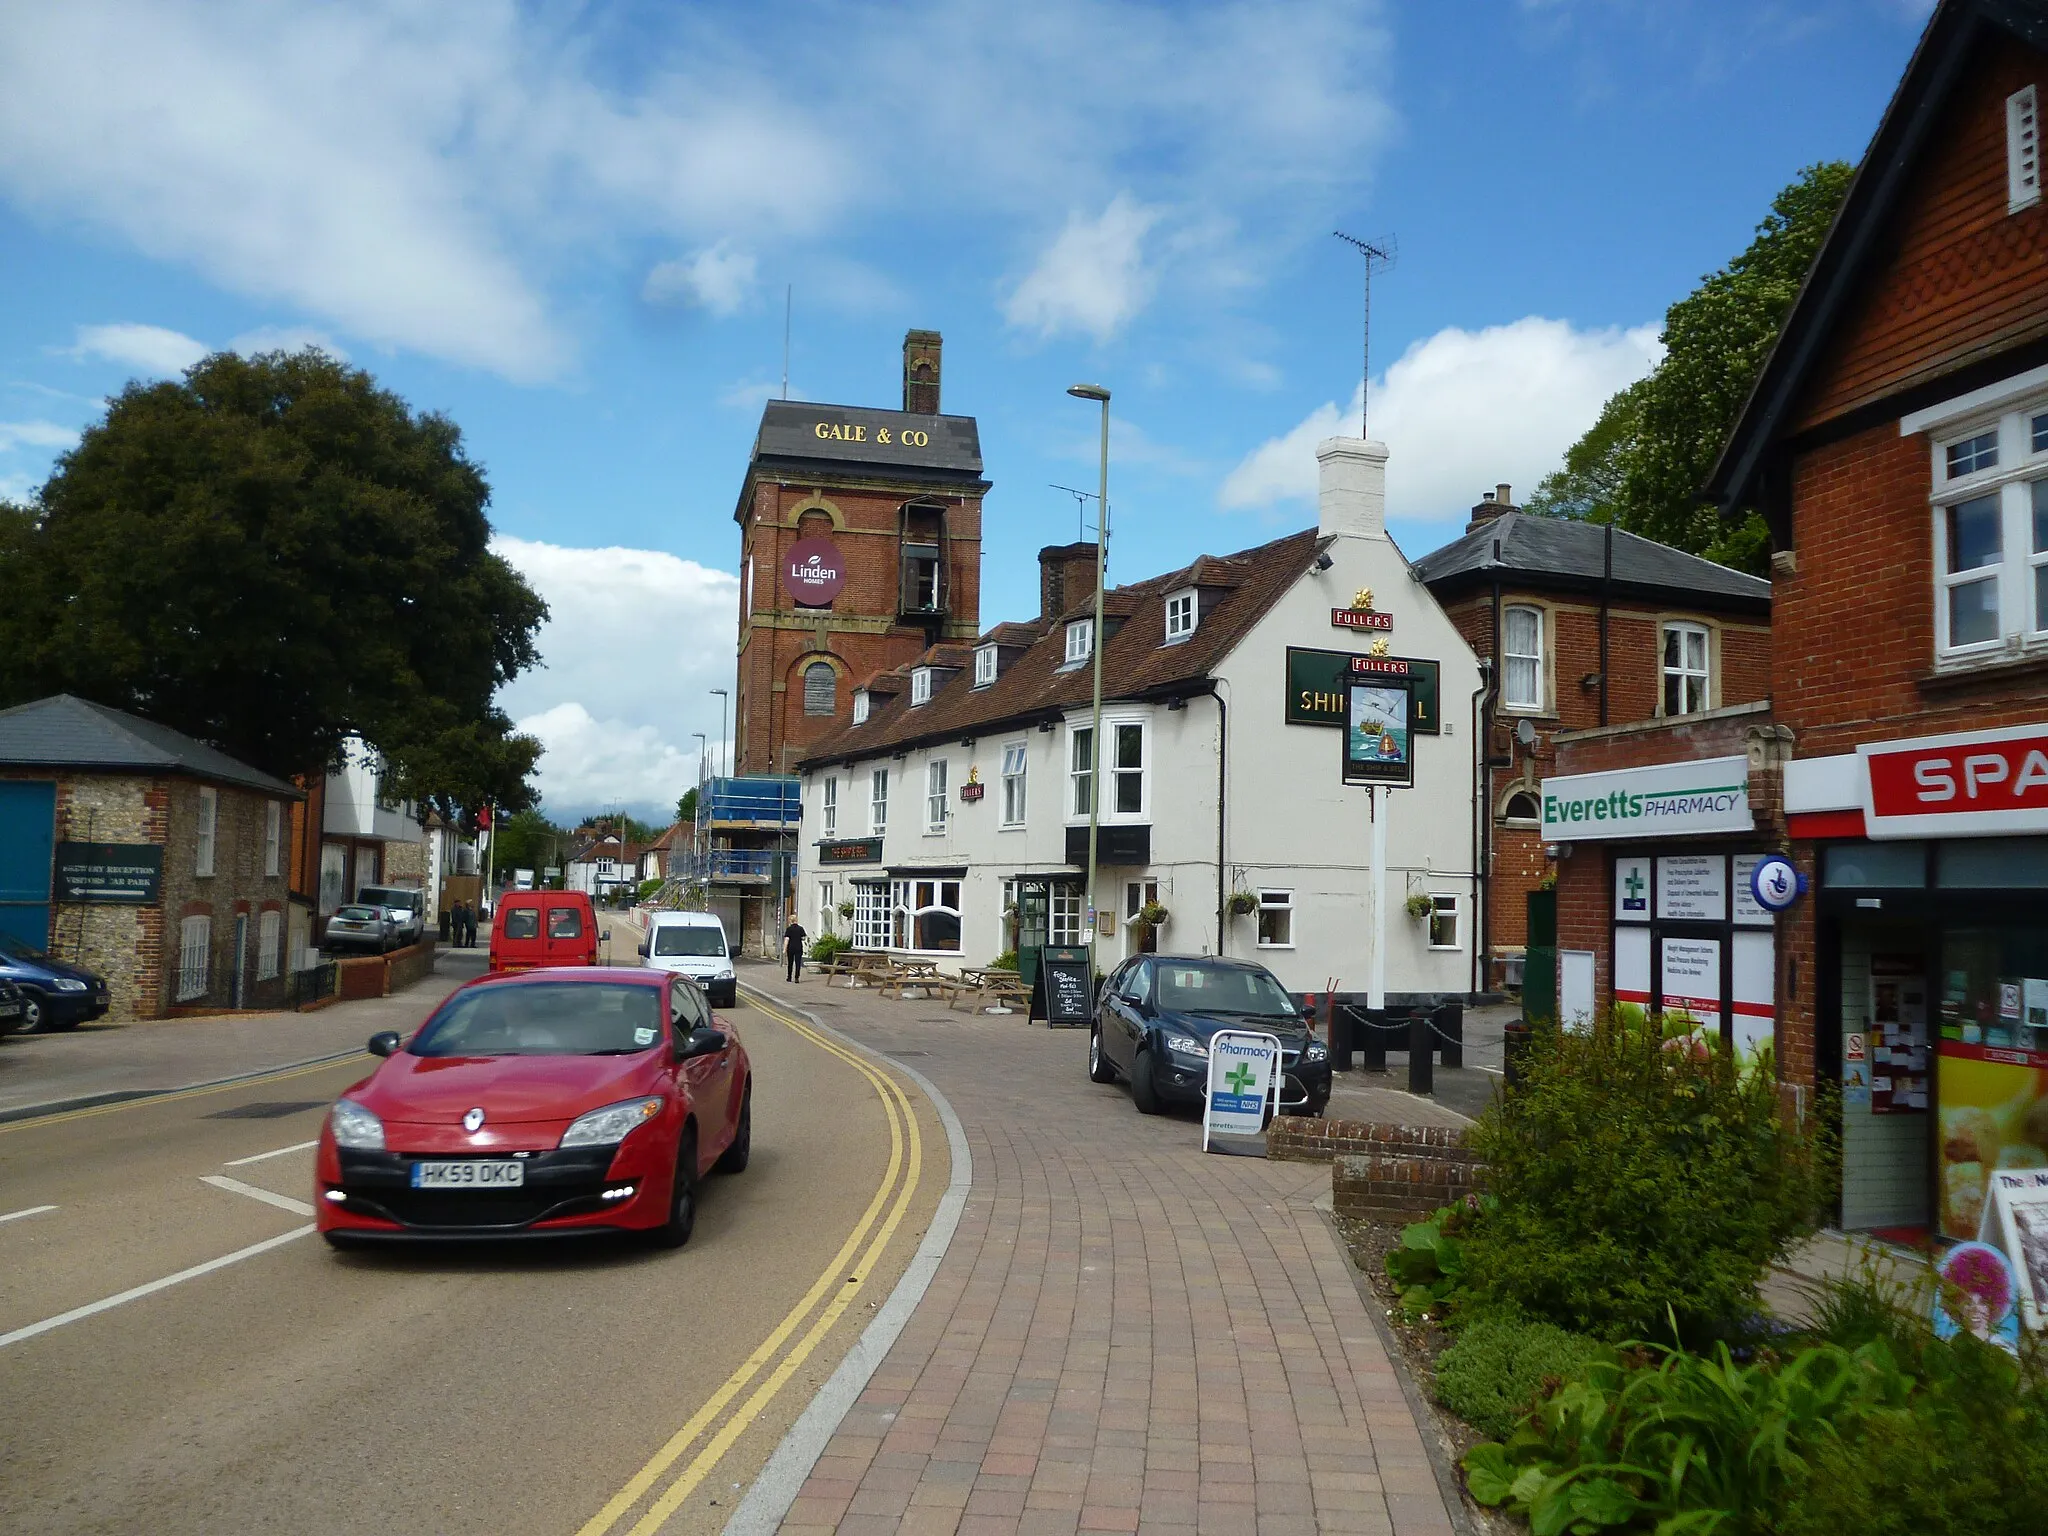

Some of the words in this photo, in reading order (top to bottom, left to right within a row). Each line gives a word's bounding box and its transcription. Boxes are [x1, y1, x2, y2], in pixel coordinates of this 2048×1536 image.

[815, 423, 867, 442] GALE
[876, 428, 892, 444] &
[901, 430, 929, 447] CO
[791, 564, 836, 580] Linden
[1544, 789, 1643, 824] Everetts
[1644, 794, 1740, 817] PHARMACY
[1219, 1042, 1272, 1060] Pharmacy
[1241, 1100, 1258, 1109] NHS
[424, 1165, 474, 1183] HK59
[480, 1164, 519, 1182] OKC
[2000, 1176, 2024, 1188] The
